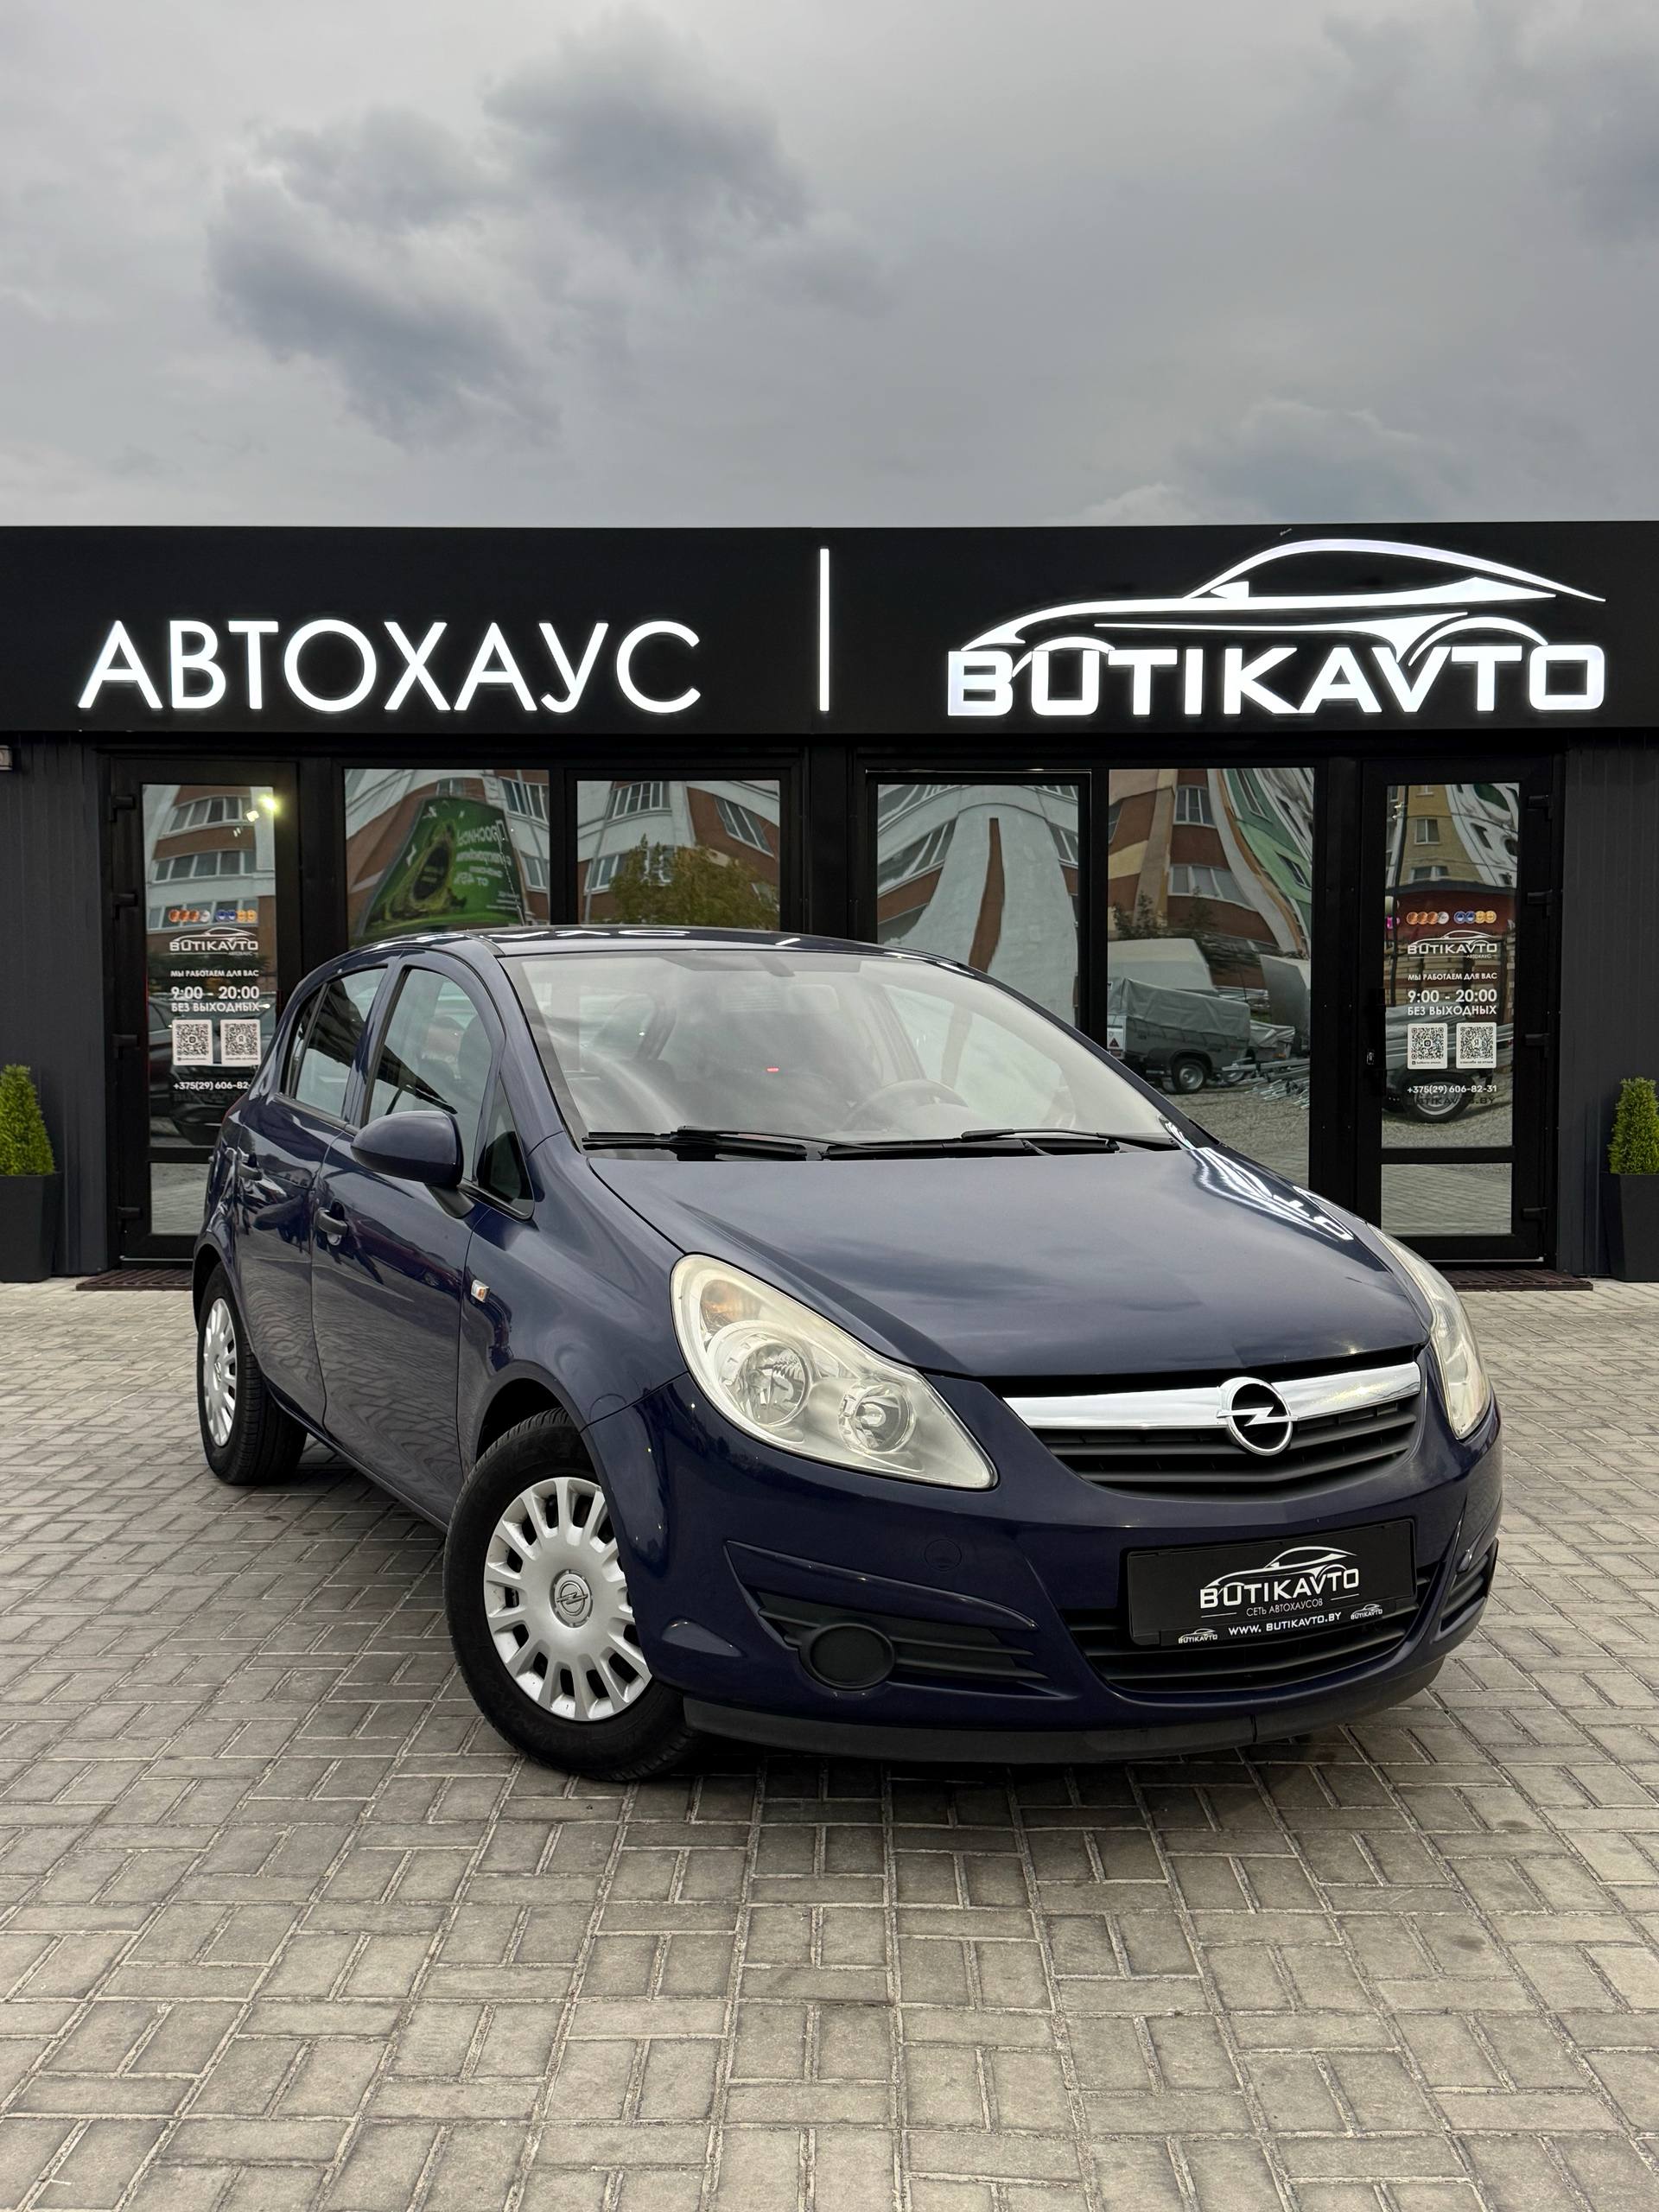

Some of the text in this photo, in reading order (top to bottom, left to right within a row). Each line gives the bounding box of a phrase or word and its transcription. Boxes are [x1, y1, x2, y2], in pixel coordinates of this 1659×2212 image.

[78, 619, 702, 714] АВТОХАУС
[947, 644, 1605, 715] BUTIKAVTO
[169, 940, 258, 951] BUTIKAVTO
[1408, 943, 1497, 955] BUTIKAVTO
[171, 986, 203, 999] 9:00
[219, 986, 260, 999] 20:00
[1408, 989, 1440, 1003] 9:00
[1455, 988, 1497, 1002] 20:00
[171, 1002, 259, 1014] БЕЗ ВЫХОДНЫХ
[1408, 1005, 1497, 1016] БЕЗ ВЫХОДНЫХ
[174, 1081, 213, 1090] +375(29)
[1408, 1085, 1497, 1095] +375(29) 606-82-31
[1199, 1567, 1360, 1609] BUTIKAVTO
[1246, 1599, 1324, 1617] СЕТЬ АВТОХАУСОВ
[1351, 1607, 1383, 1620] BUTIKAVTO
[1228, 1611, 1342, 1636] WWW. BUTIKAVTO.BY
